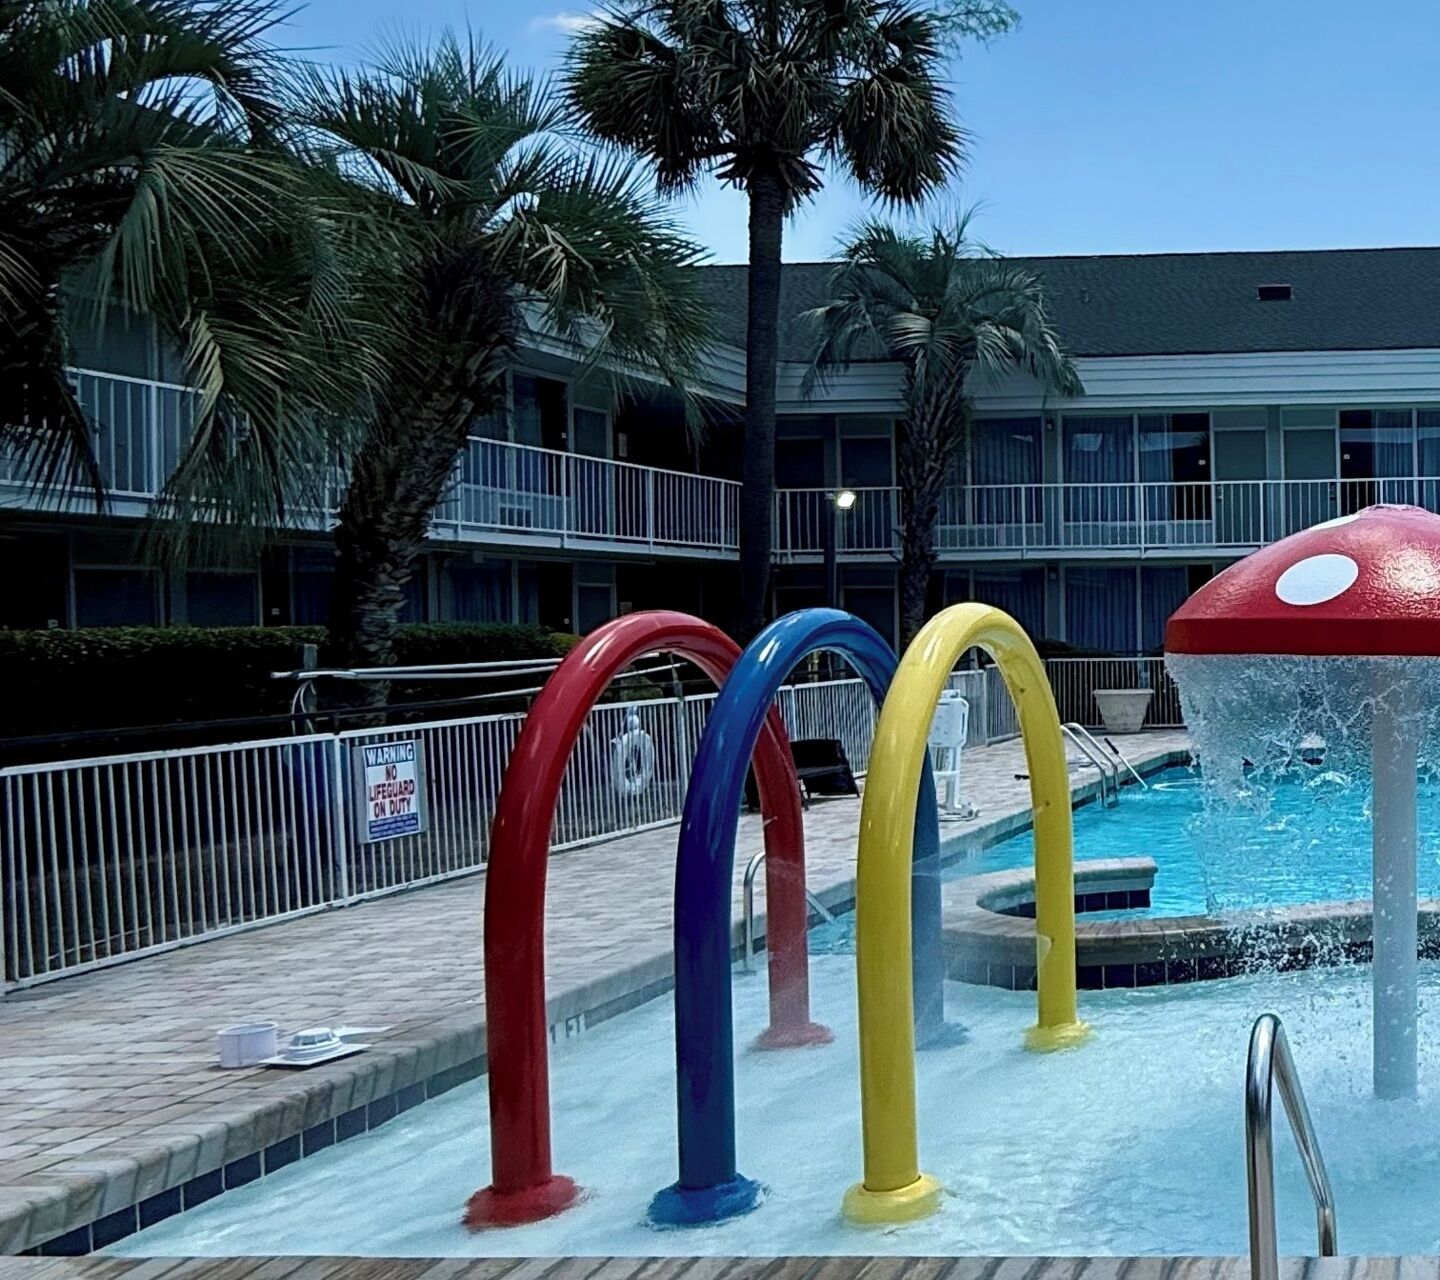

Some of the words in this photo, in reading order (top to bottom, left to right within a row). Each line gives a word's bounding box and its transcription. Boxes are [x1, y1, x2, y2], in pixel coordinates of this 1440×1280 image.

[366, 744, 413, 766] WARNING
[385, 765, 397, 781] NO
[368, 779, 415, 802] LIFEGUARD
[373, 803, 387, 819] ON
[389, 797, 411, 816] DUTY
[565, 1014, 581, 1039] FT
